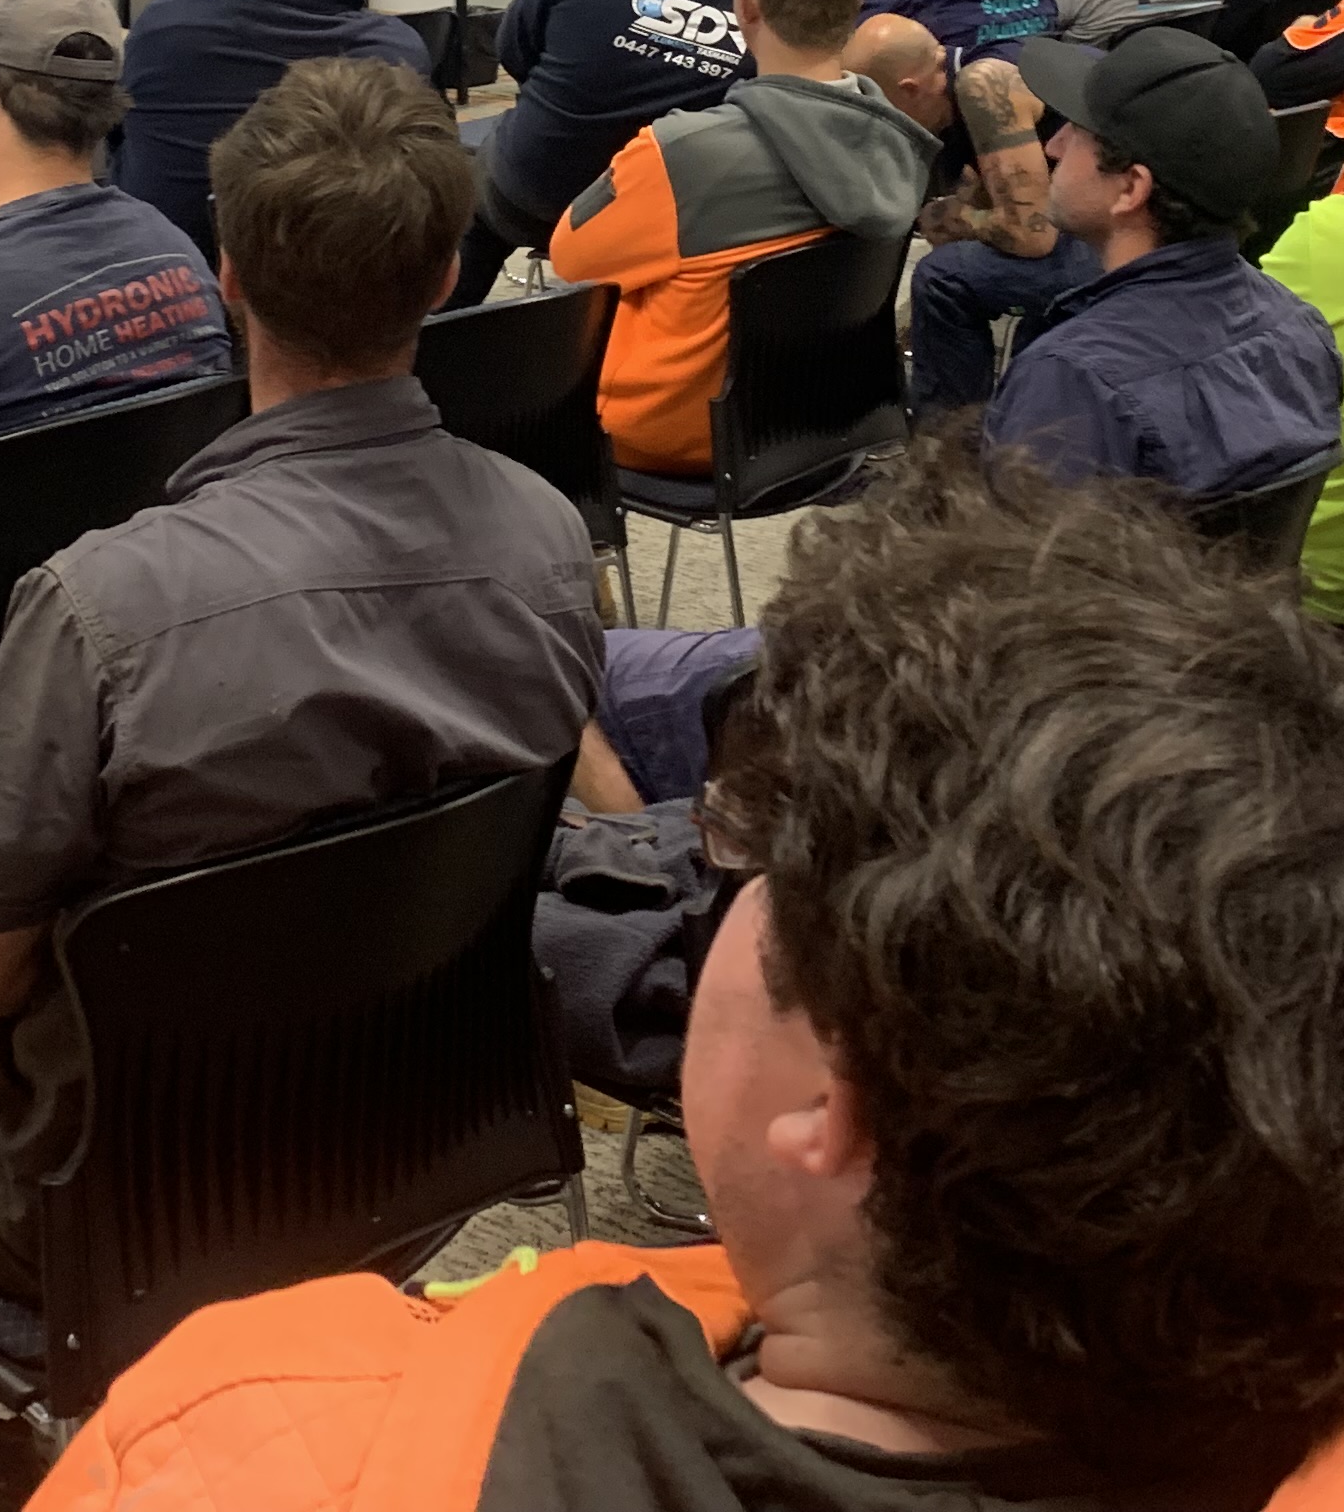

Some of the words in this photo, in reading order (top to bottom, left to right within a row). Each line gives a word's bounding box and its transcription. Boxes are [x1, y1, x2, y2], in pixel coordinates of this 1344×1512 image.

[613, 34, 660, 58] 0447
[663, 50, 696, 69] 143
[697, 60, 733, 80] 397
[696, 46, 741, 66] TASMANIA
[19, 265, 201, 352] HYDRONIC
[33, 328, 114, 378] HOME
